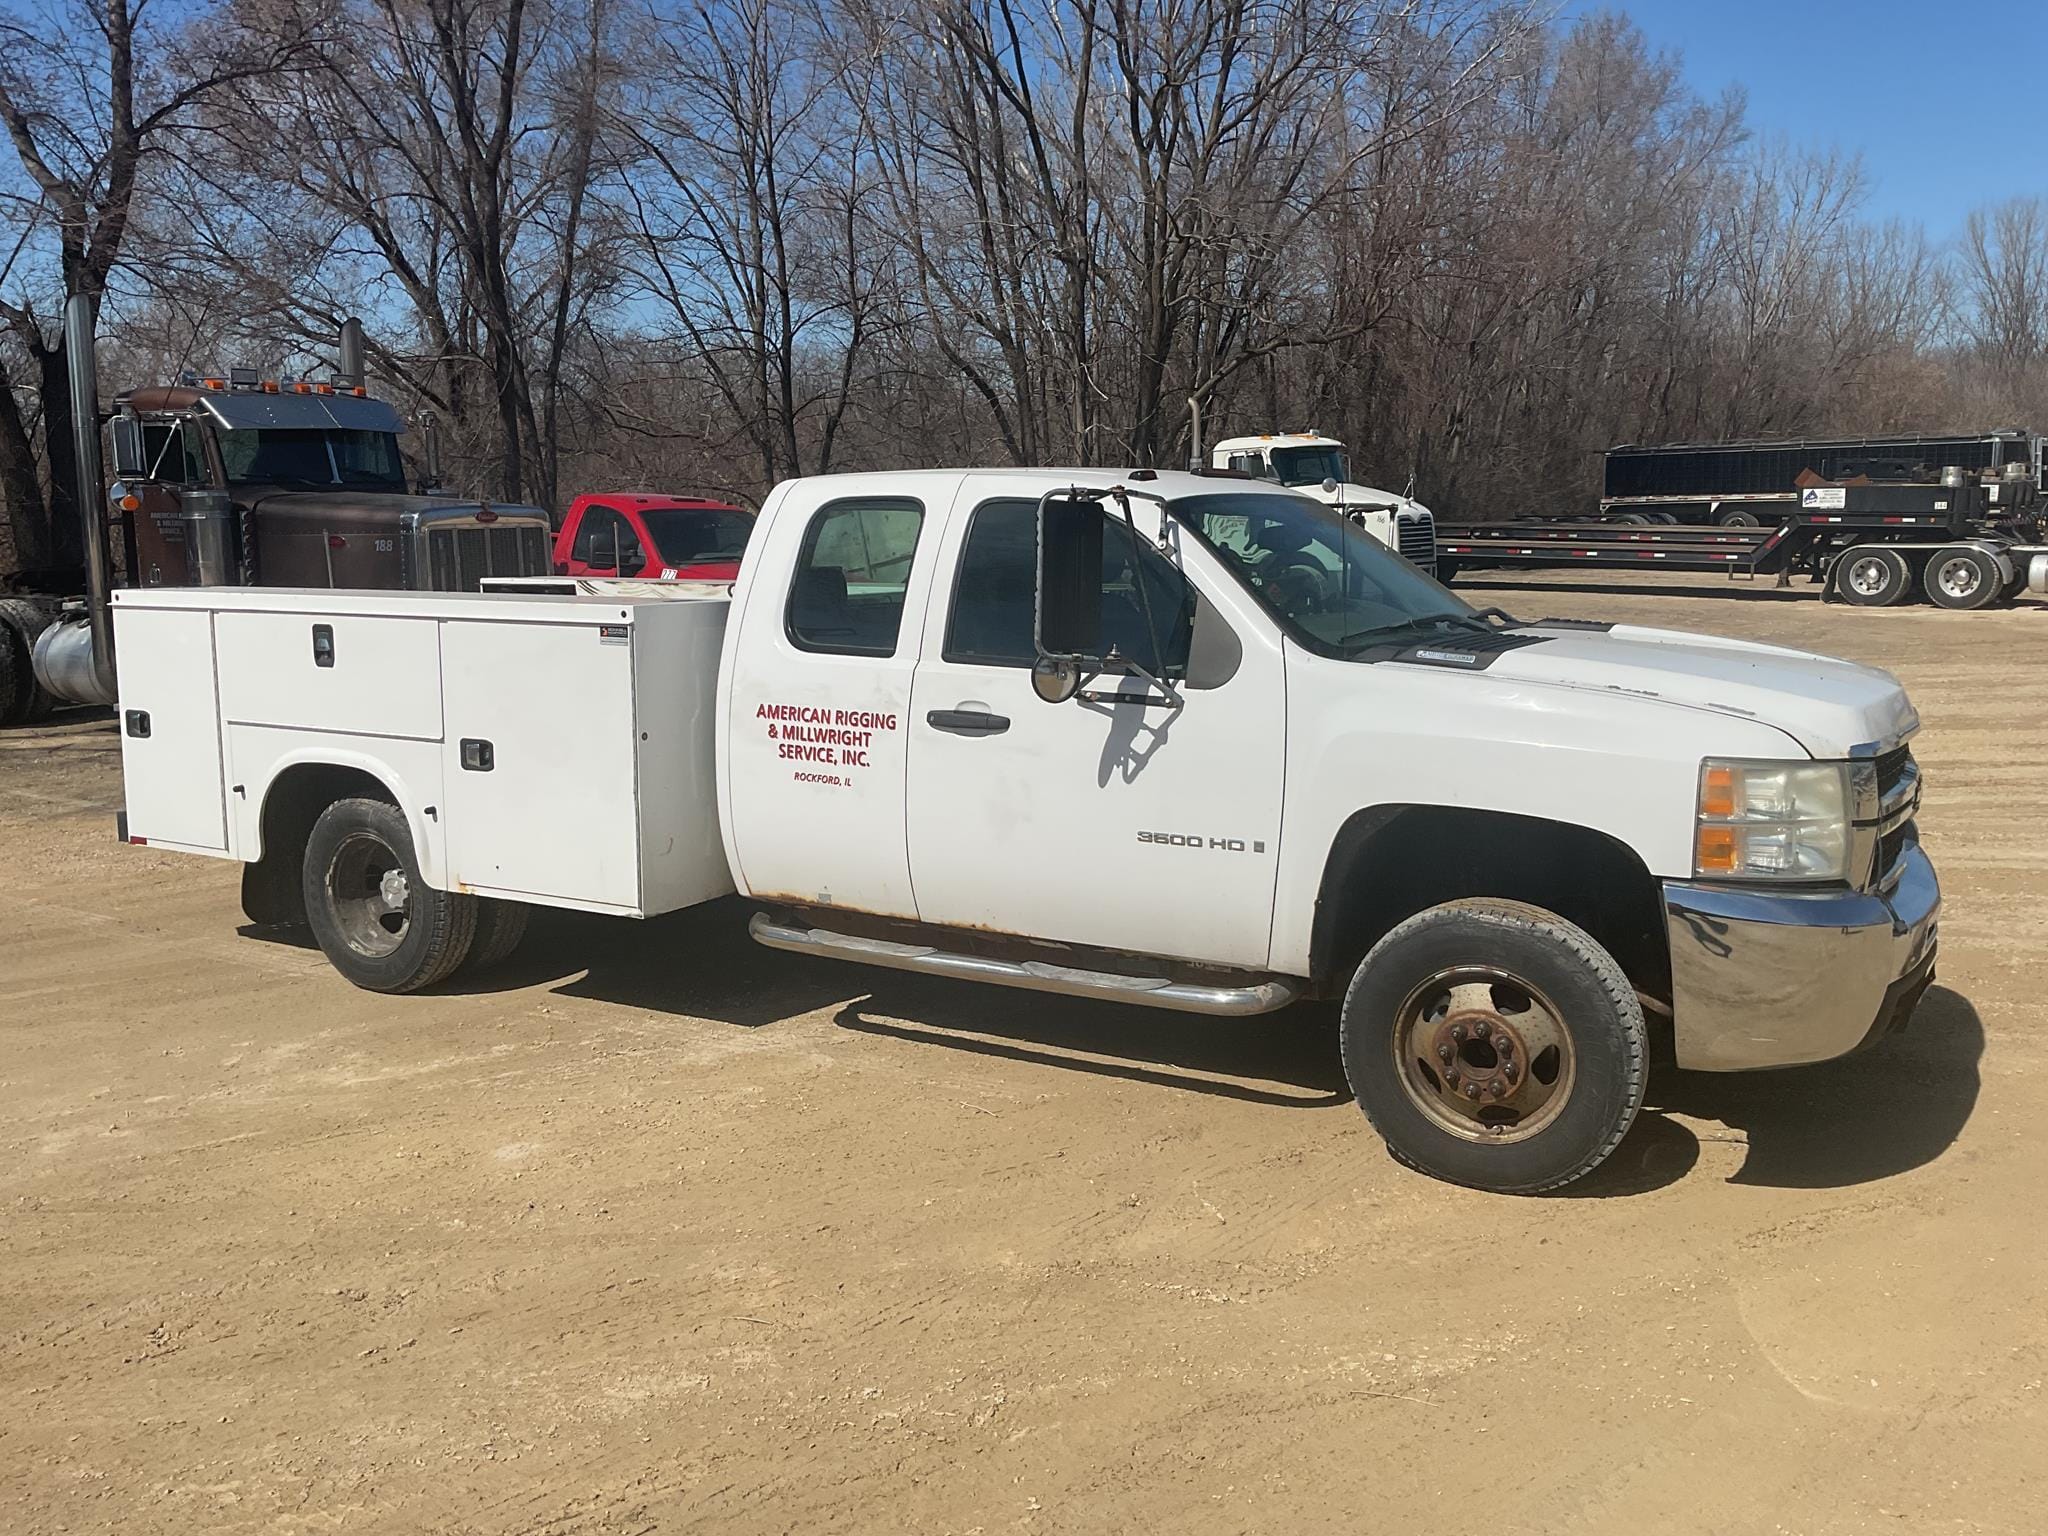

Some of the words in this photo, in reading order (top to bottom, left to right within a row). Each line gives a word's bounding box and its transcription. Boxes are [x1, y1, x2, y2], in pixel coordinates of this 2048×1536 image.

[374, 540, 393, 552] 188
[756, 703, 831, 724] AMERICAN
[835, 710, 897, 730] RIGGING
[768, 723, 778, 739] &
[782, 725, 872, 748] MILLWRIGHT
[778, 743, 838, 766] SERVICE,
[842, 750, 871, 767] INC.
[794, 772, 842, 786] ROCKFORD,
[844, 777, 852, 787] IL
[1137, 830, 1203, 848] 3500
[1209, 837, 1245, 852] HD
